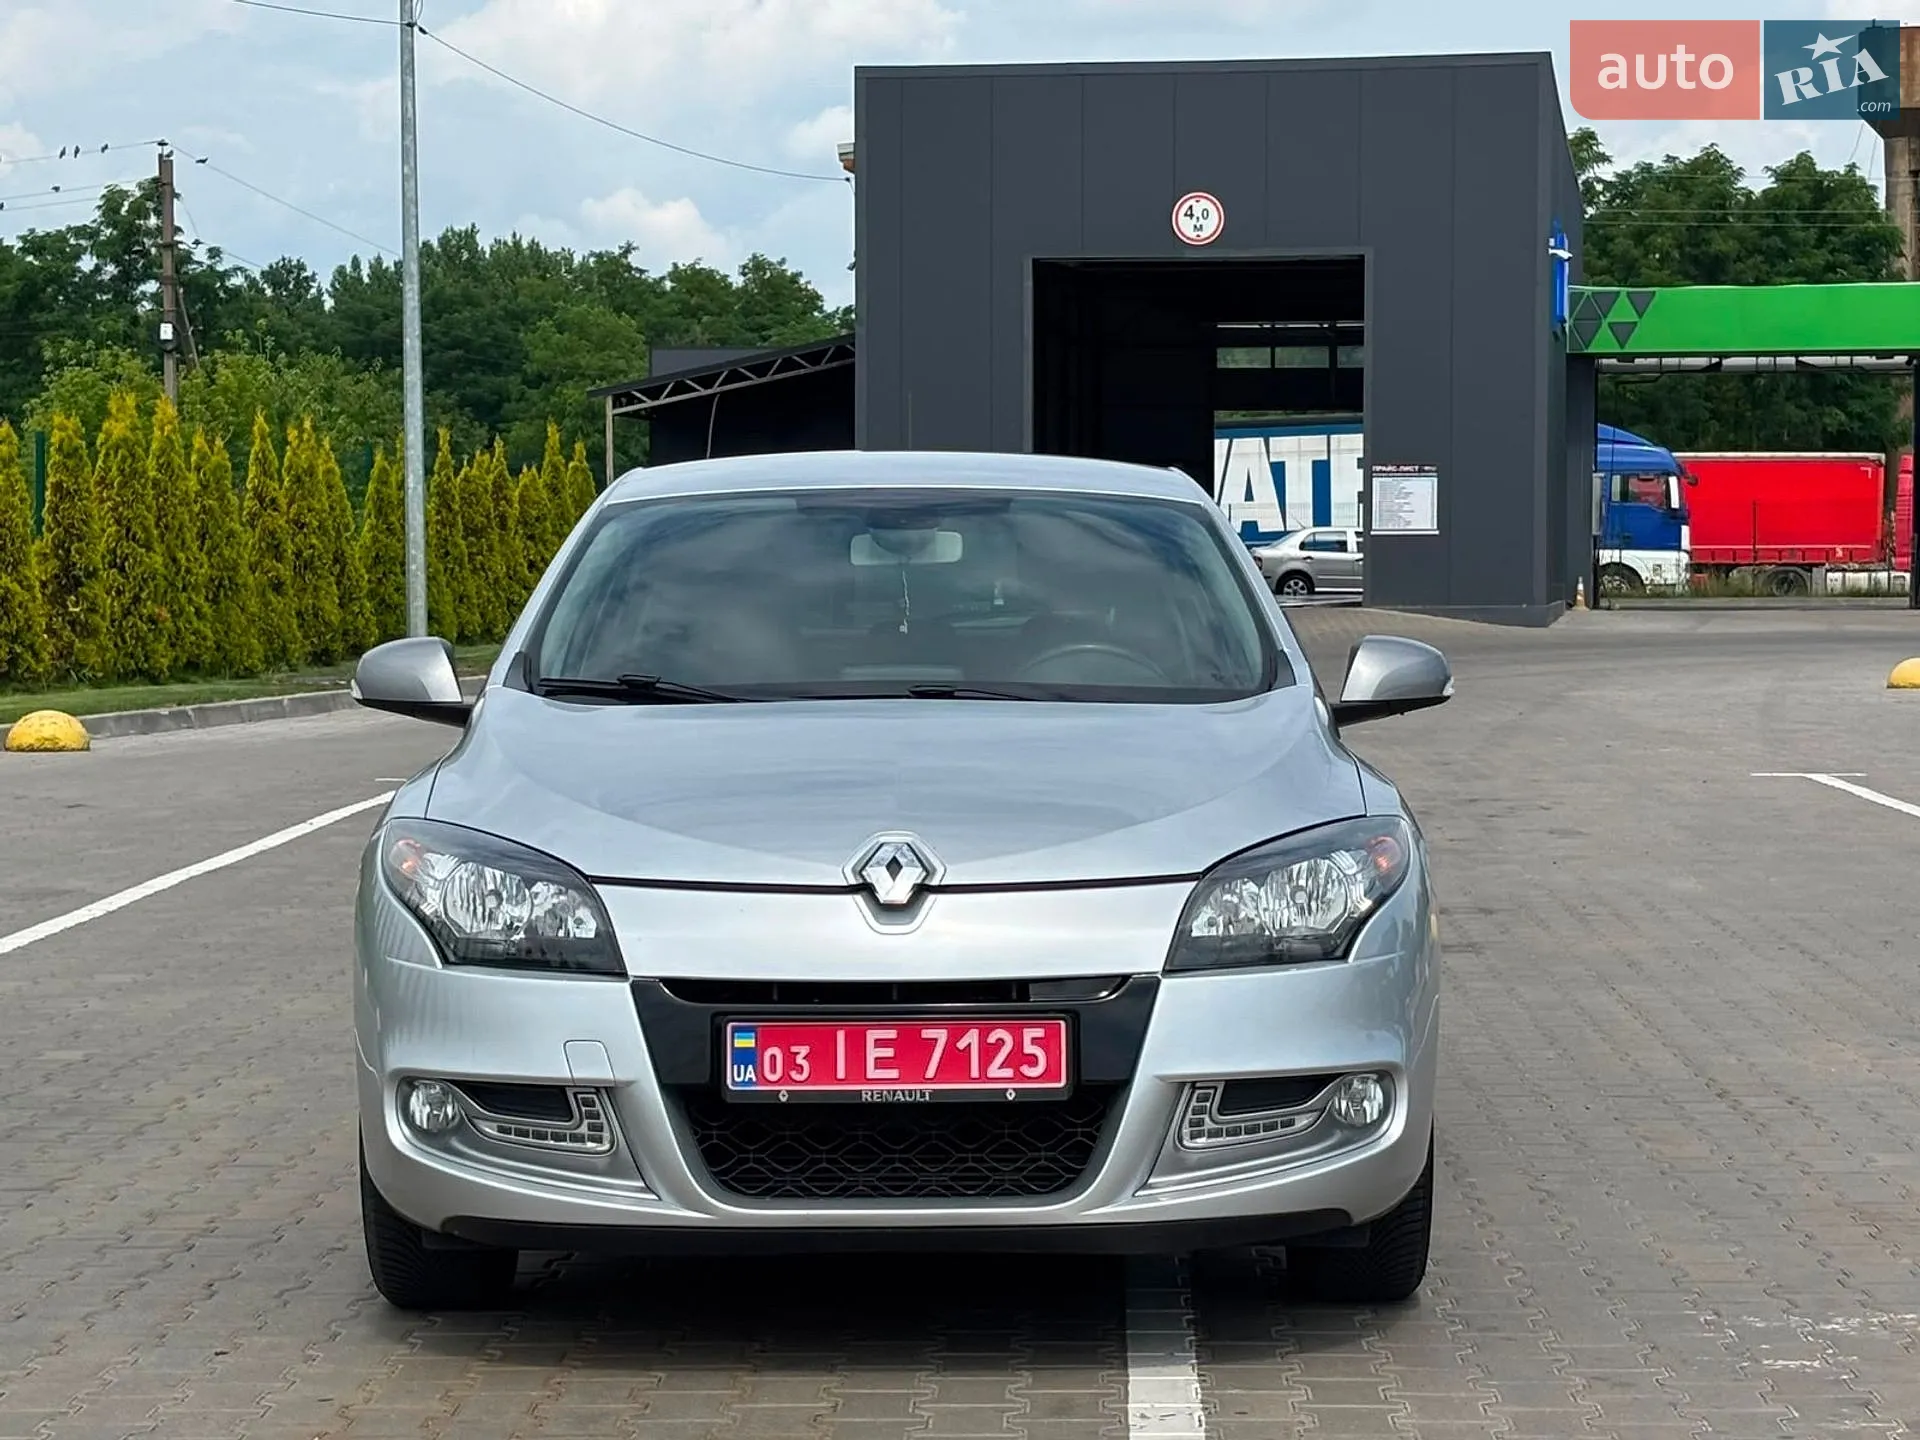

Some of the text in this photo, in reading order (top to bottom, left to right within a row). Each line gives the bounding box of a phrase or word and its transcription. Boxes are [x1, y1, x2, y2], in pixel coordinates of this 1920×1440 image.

[733, 1065, 756, 1082] UA
[763, 1046, 811, 1082] 03
[920, 1028, 1047, 1079] 7125
[861, 1089, 932, 1102] RENAULT
